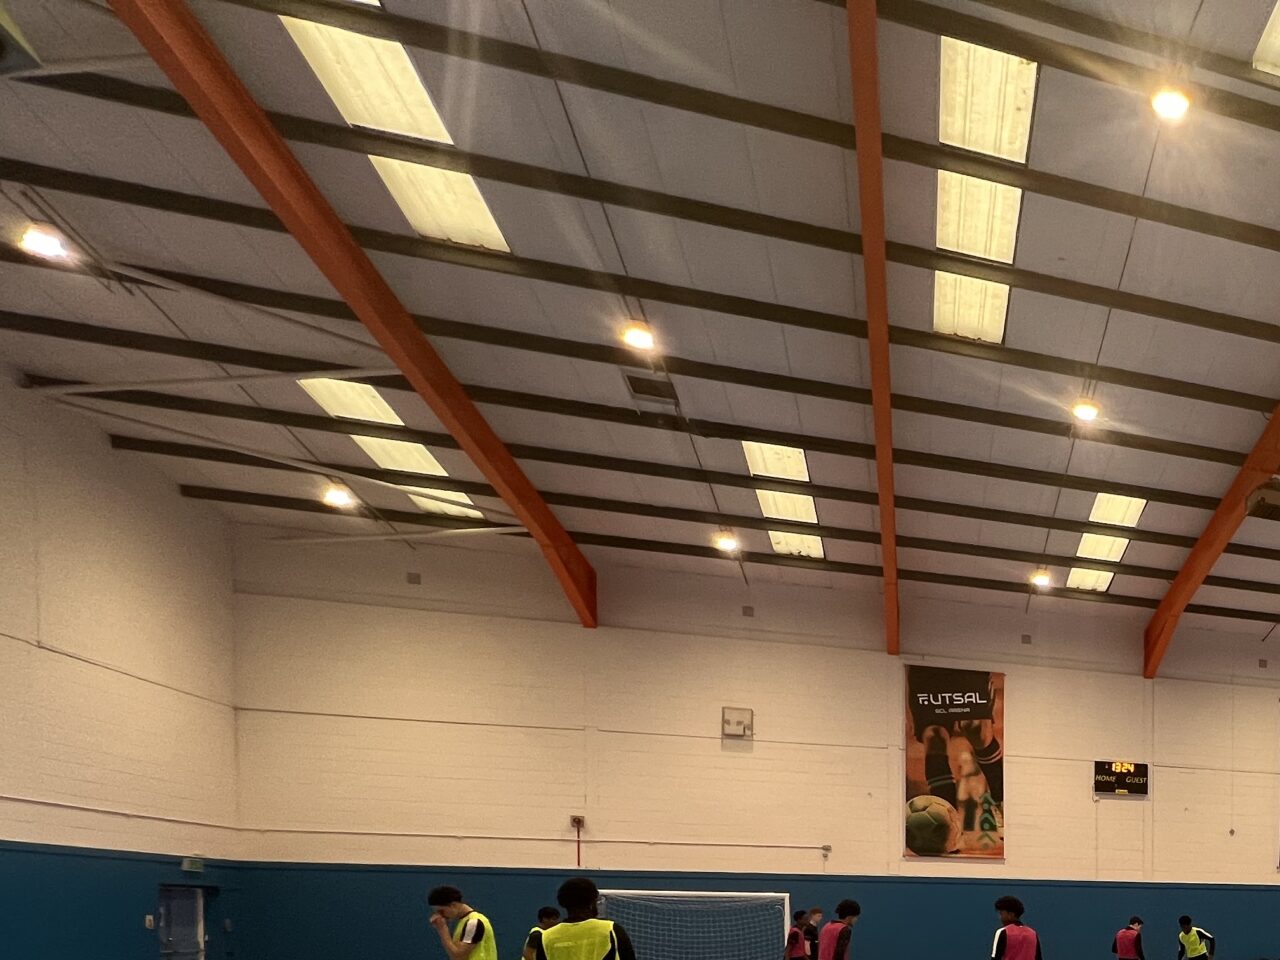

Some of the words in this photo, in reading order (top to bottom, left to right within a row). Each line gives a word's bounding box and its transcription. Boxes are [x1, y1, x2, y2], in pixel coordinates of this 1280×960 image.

[917, 692, 987, 705] FUTSAL
[1095, 774, 1116, 782] HOME
[1125, 775, 1147, 784] GUEST
